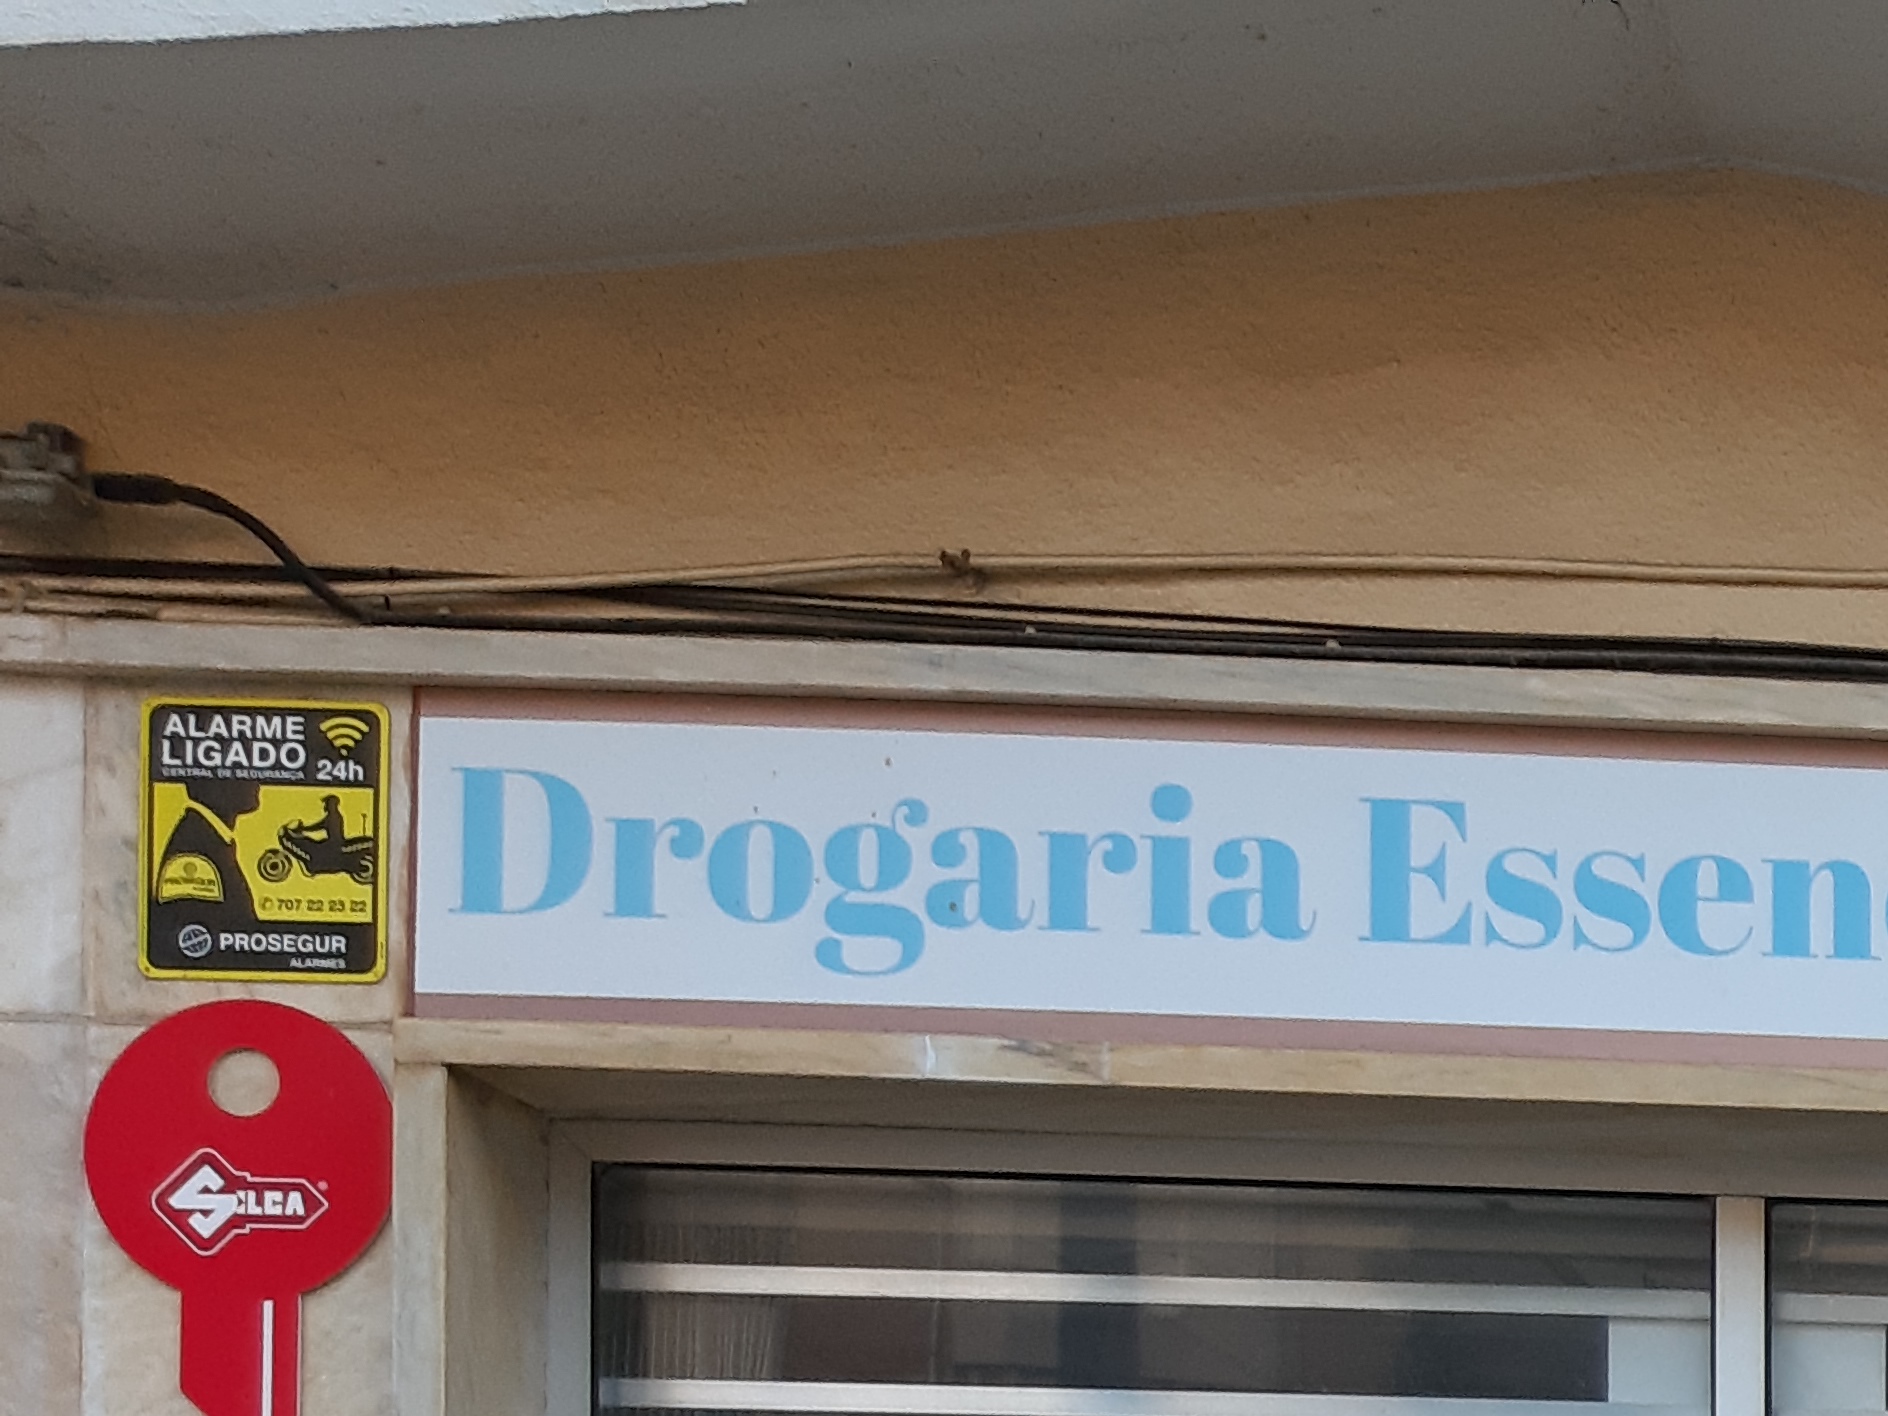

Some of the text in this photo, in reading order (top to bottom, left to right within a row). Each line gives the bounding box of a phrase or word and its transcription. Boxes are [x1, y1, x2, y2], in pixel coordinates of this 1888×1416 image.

[162, 712, 307, 742] ALARME
[161, 741, 307, 770] LIGADO
[315, 759, 365, 782] 24h
[447, 765, 1317, 977] Drogaria
[219, 931, 348, 953] PROSEGUR
[167, 1164, 306, 1239] SILCA
